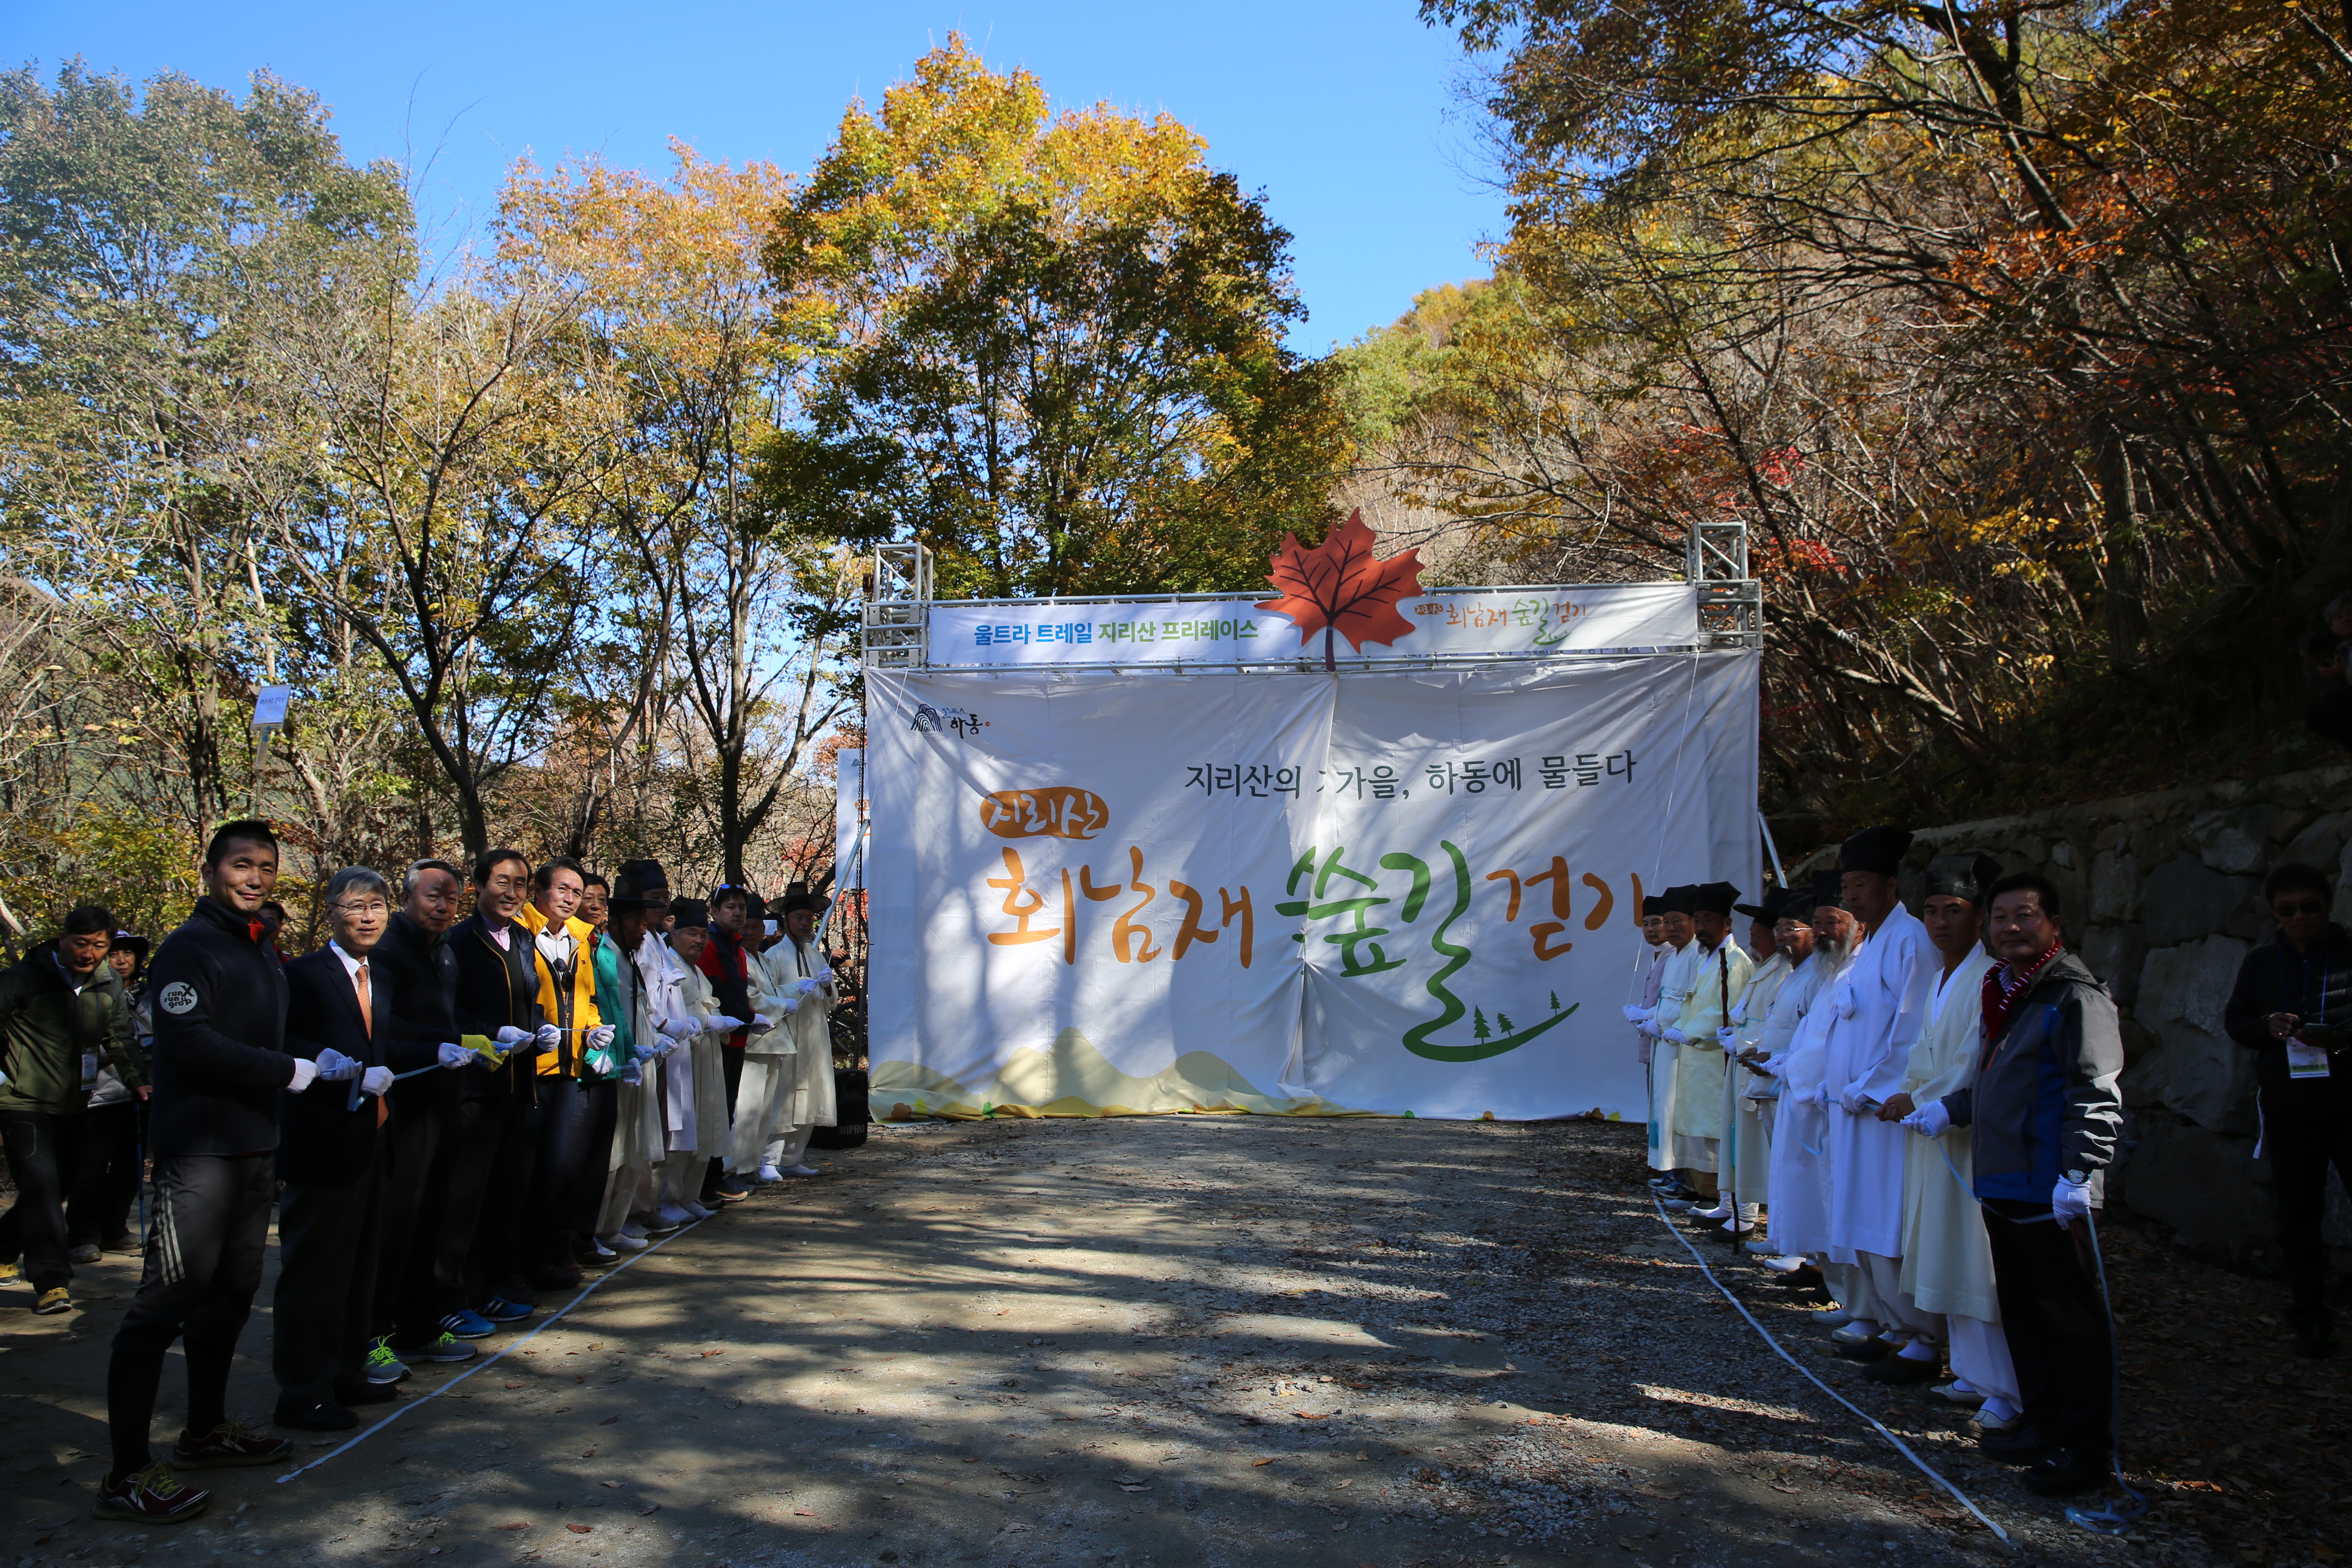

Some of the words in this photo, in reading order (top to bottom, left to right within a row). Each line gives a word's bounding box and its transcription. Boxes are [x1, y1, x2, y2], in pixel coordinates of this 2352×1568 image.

[974, 623, 1031, 646] 울트라
[1036, 622, 1092, 644] 트레일
[1098, 620, 1156, 644] 지리산
[1160, 618, 1259, 641] 프리레이스
[1416, 603, 1443, 615] 지리산
[1446, 601, 1507, 628] 회남재
[1511, 597, 1550, 646] 숲길
[1552, 601, 1586, 624] 걷기
[942, 707, 969, 719] 알프스
[950, 713, 983, 739] 하동
[1185, 763, 1301, 800] 지리산의
[1335, 764, 1409, 801] 가을,
[1425, 757, 1523, 794] 하동에
[1538, 749, 1638, 790] 물들다
[987, 791, 1107, 837] 지리산
[986, 845, 1254, 969] 회남재
[1274, 839, 1472, 1062] 숲길
[1485, 855, 1645, 961] 걷기
[839, 1124, 865, 1136] MIPRO
